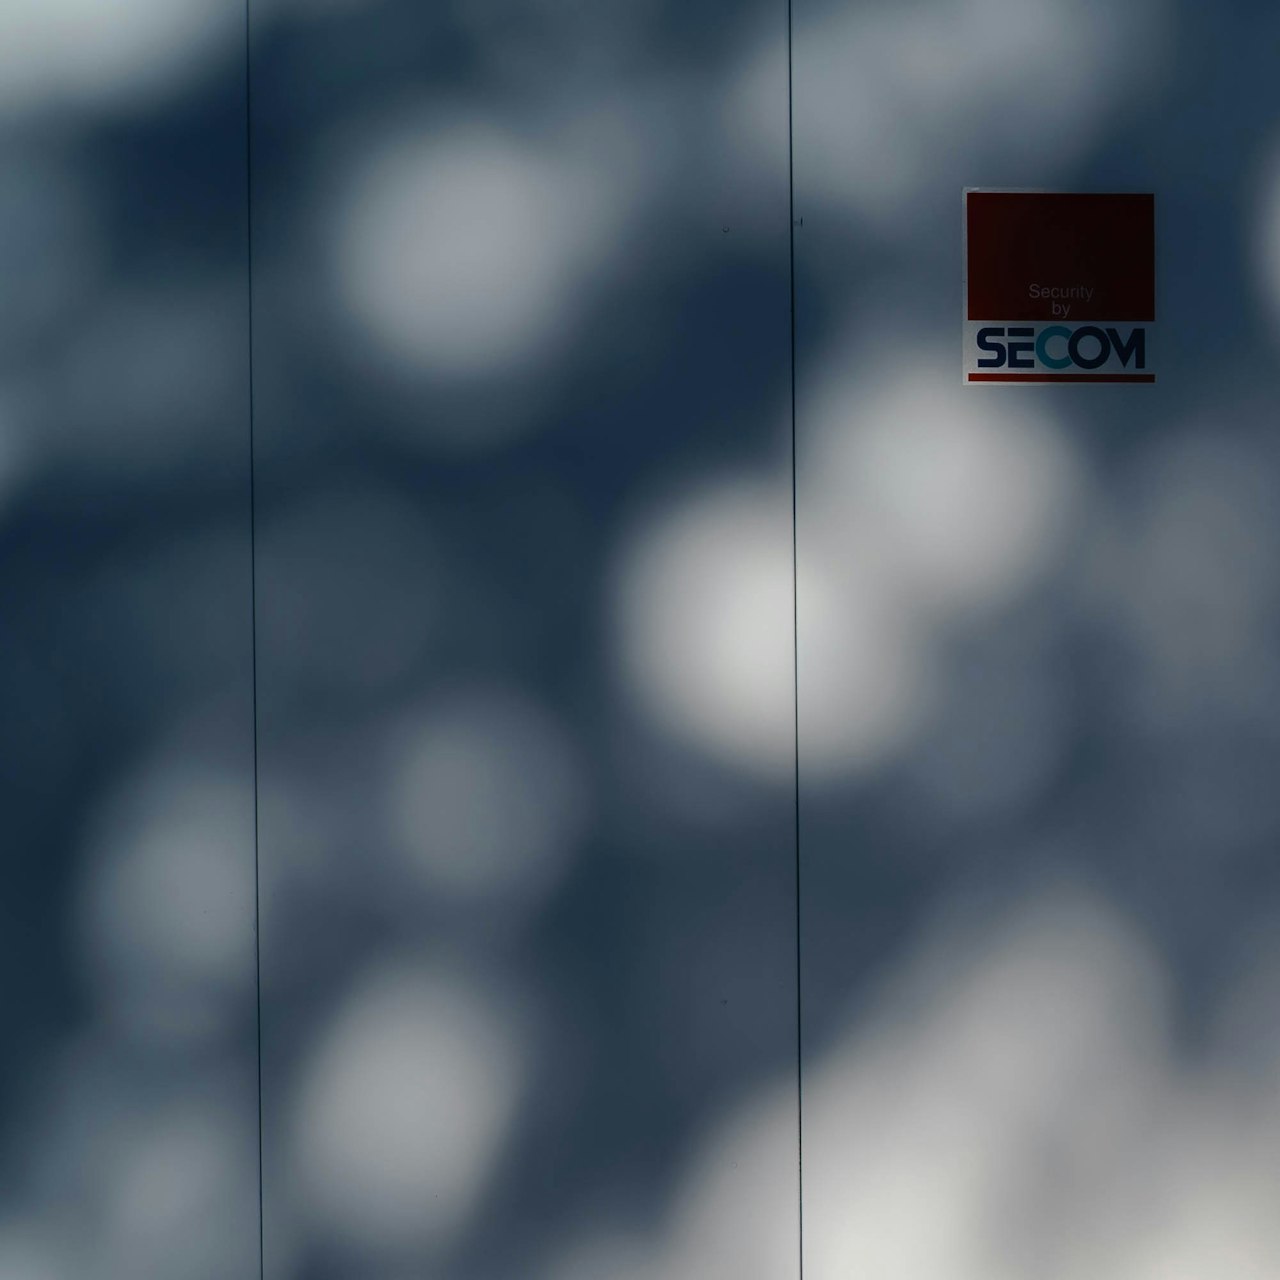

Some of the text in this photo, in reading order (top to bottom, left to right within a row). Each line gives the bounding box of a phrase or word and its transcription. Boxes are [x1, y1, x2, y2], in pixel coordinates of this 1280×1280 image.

[1028, 283, 1094, 302] Security
[1052, 301, 1071, 318] by
[976, 325, 1145, 370] SECOM
